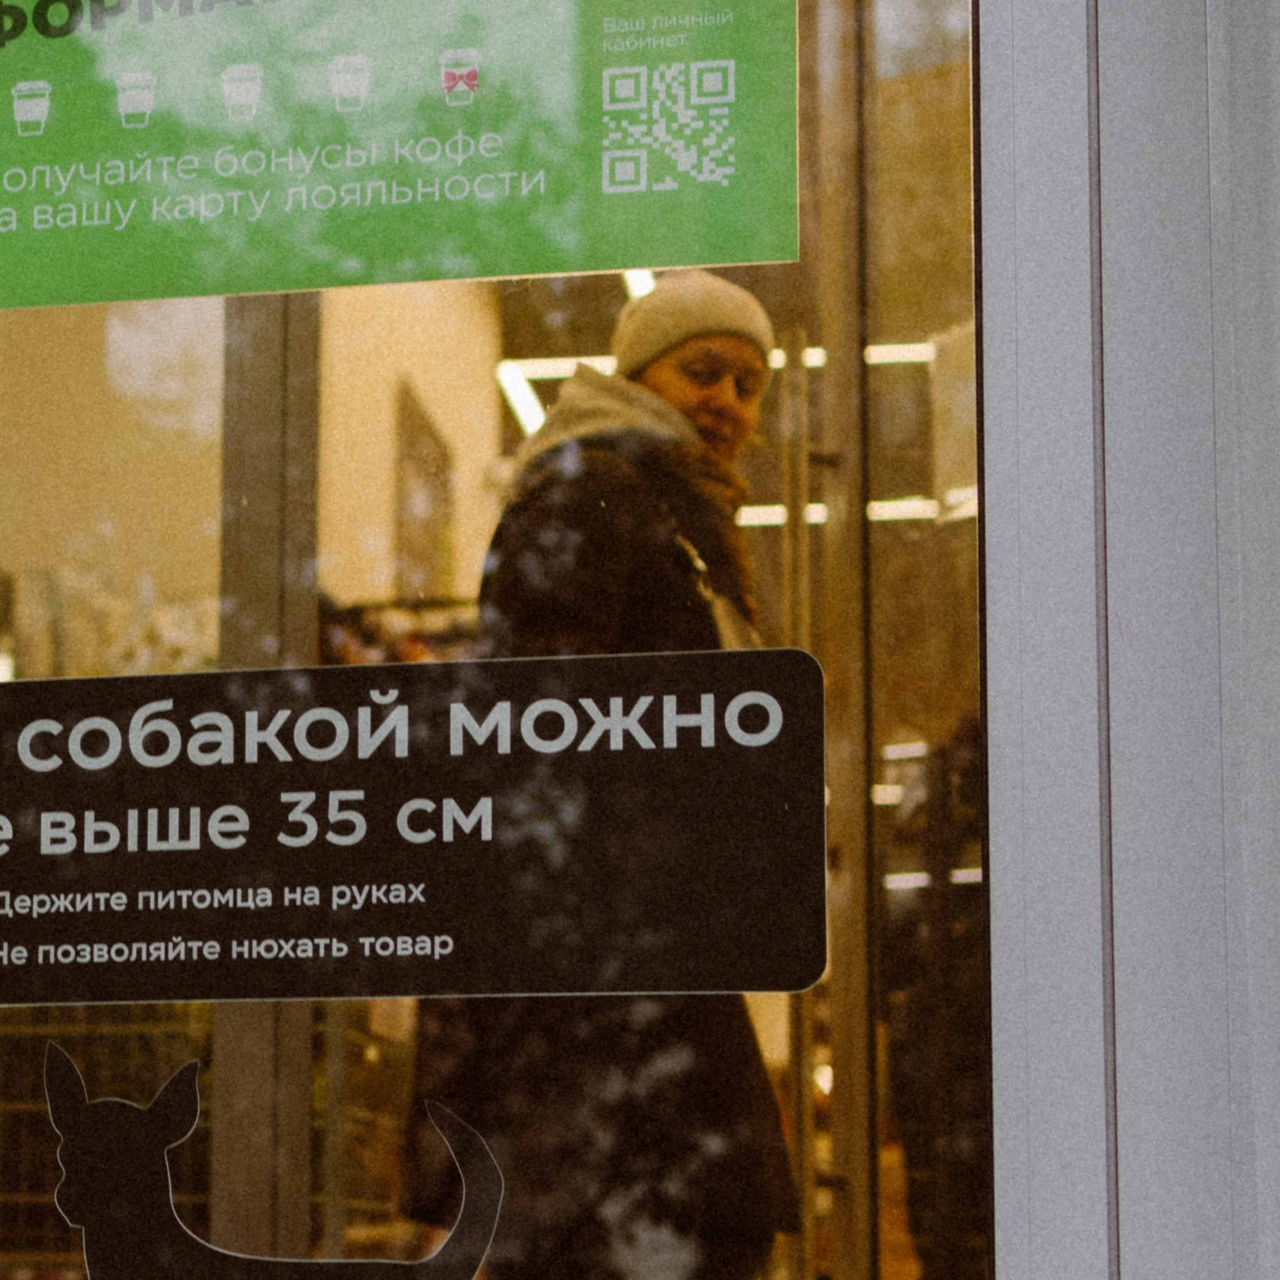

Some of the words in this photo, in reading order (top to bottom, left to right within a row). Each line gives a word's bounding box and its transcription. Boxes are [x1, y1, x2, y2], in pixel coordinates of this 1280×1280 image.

[603, 17, 645, 33] Ваш
[652, 10, 733, 29] личный
[603, 31, 687, 52] кабинет
[214, 138, 378, 184] бонусы
[394, 127, 502, 167] кофе
[32, 194, 137, 230] вашу
[152, 185, 271, 223] карту
[282, 168, 546, 214] лояльности
[17, 689, 409, 772] собакой
[449, 691, 783, 756] можно
[40, 804, 250, 855] выше
[276, 789, 367, 848] 35
[396, 797, 493, 844] см
[138, 884, 273, 912] питомца
[283, 884, 320, 906] на
[331, 882, 426, 911] руках
[37, 935, 220, 964] позволяйте
[231, 937, 348, 959] нюхать
[359, 931, 454, 959] товар
